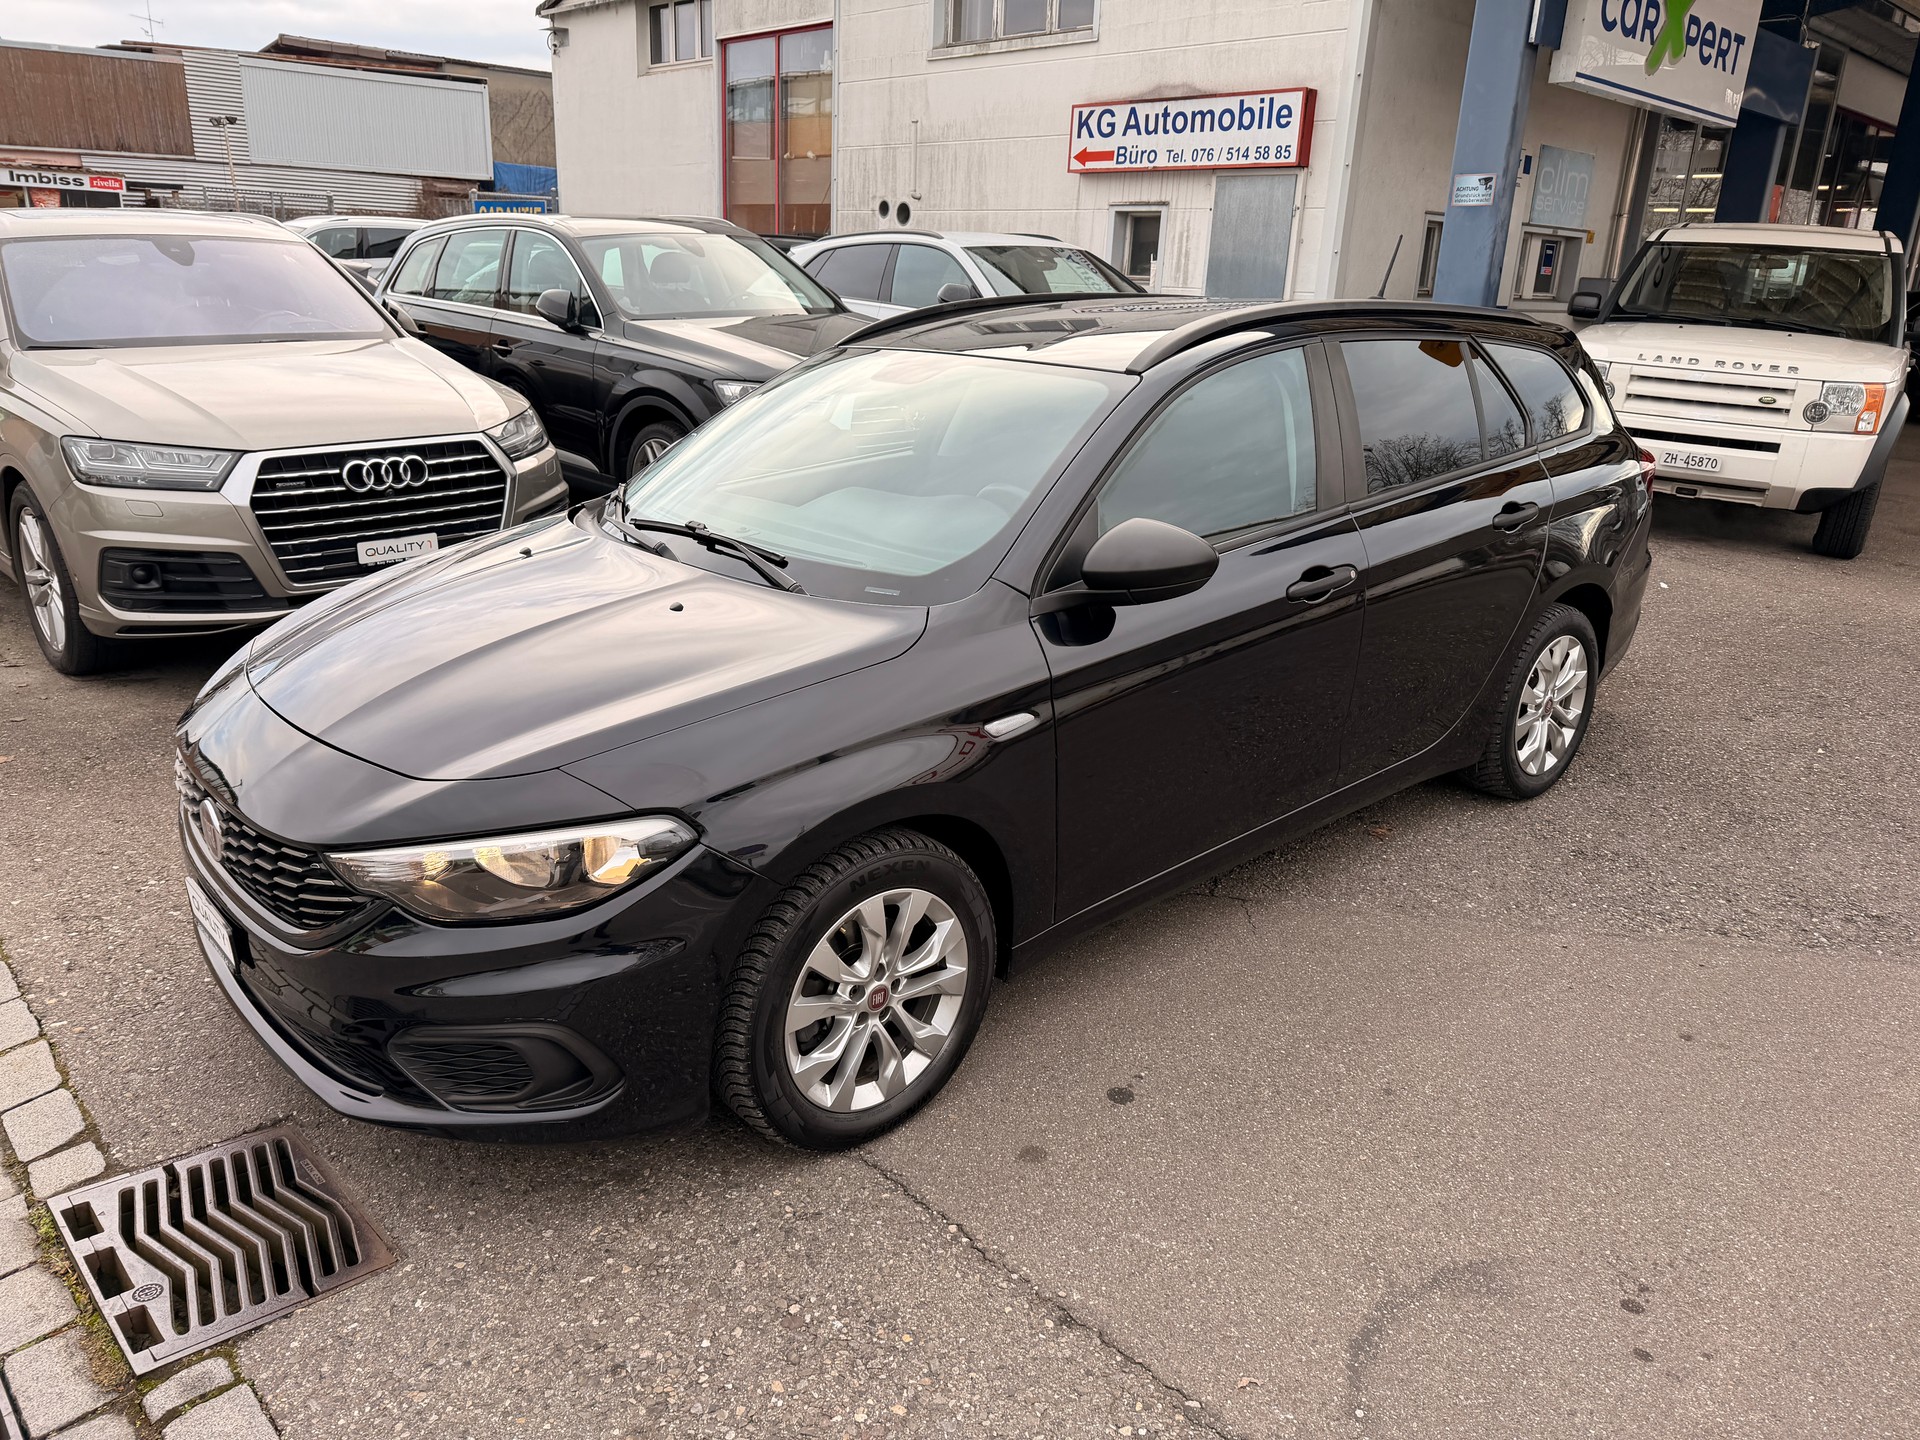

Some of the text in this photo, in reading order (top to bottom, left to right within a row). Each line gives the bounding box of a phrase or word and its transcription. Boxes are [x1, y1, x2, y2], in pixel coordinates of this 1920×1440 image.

[1076, 97, 1293, 140] KG Automobile
[1115, 145, 1158, 166] Büro
[1166, 148, 1187, 164] Tel.
[1191, 147, 1214, 163] 076
[1226, 145, 1250, 161] 514
[1254, 145, 1270, 161] 58
[1274, 144, 1292, 160] 85
[8, 170, 120, 188] Imbiss rivella
[1534, 195, 1585, 216] service
[1637, 353, 1800, 375] LAND ROVER
[365, 540, 425, 557] QUALITY
[849, 860, 931, 893] NEXEN
[872, 991, 885, 1006] FIAT
